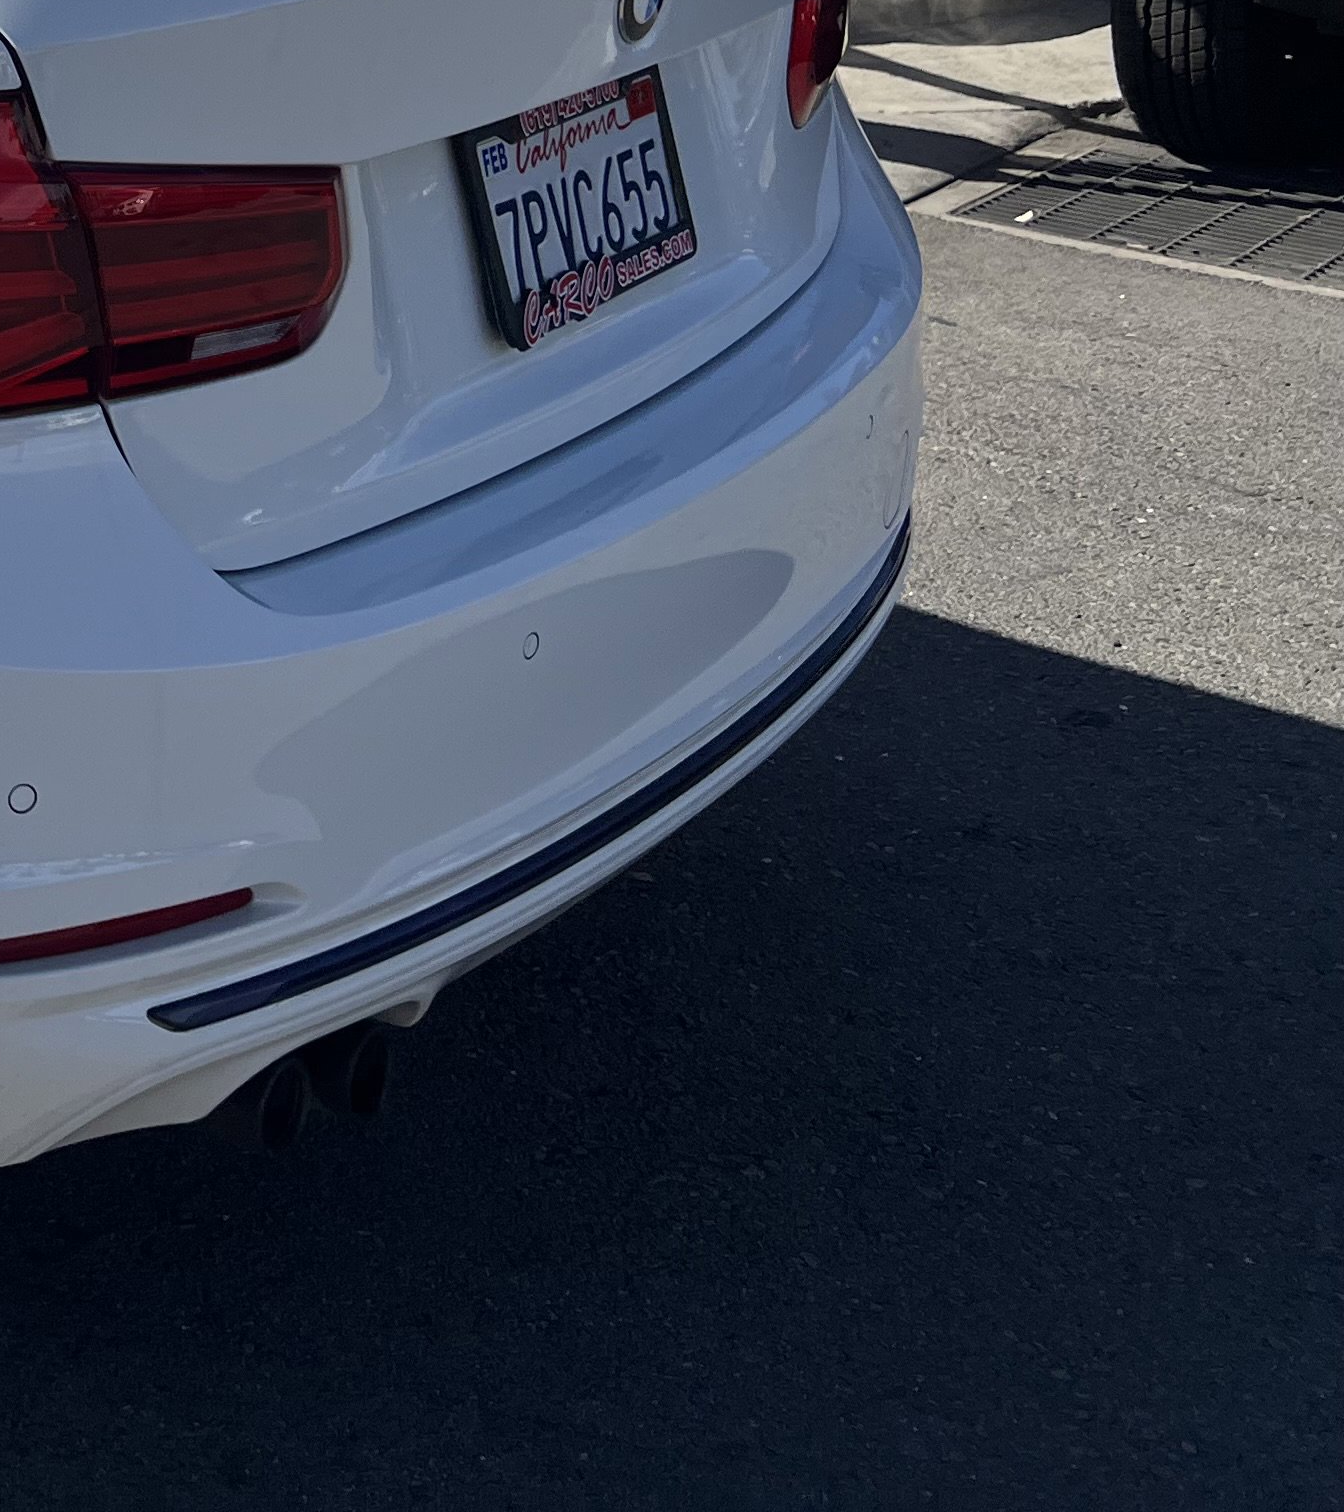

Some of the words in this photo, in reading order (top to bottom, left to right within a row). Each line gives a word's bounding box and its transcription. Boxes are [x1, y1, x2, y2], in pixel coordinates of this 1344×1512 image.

[481, 142, 509, 177] FEB
[515, 106, 631, 175] California
[495, 138, 670, 291] 7PVC655
[524, 255, 615, 348] CARCO
[616, 228, 694, 287] SALES.COM
